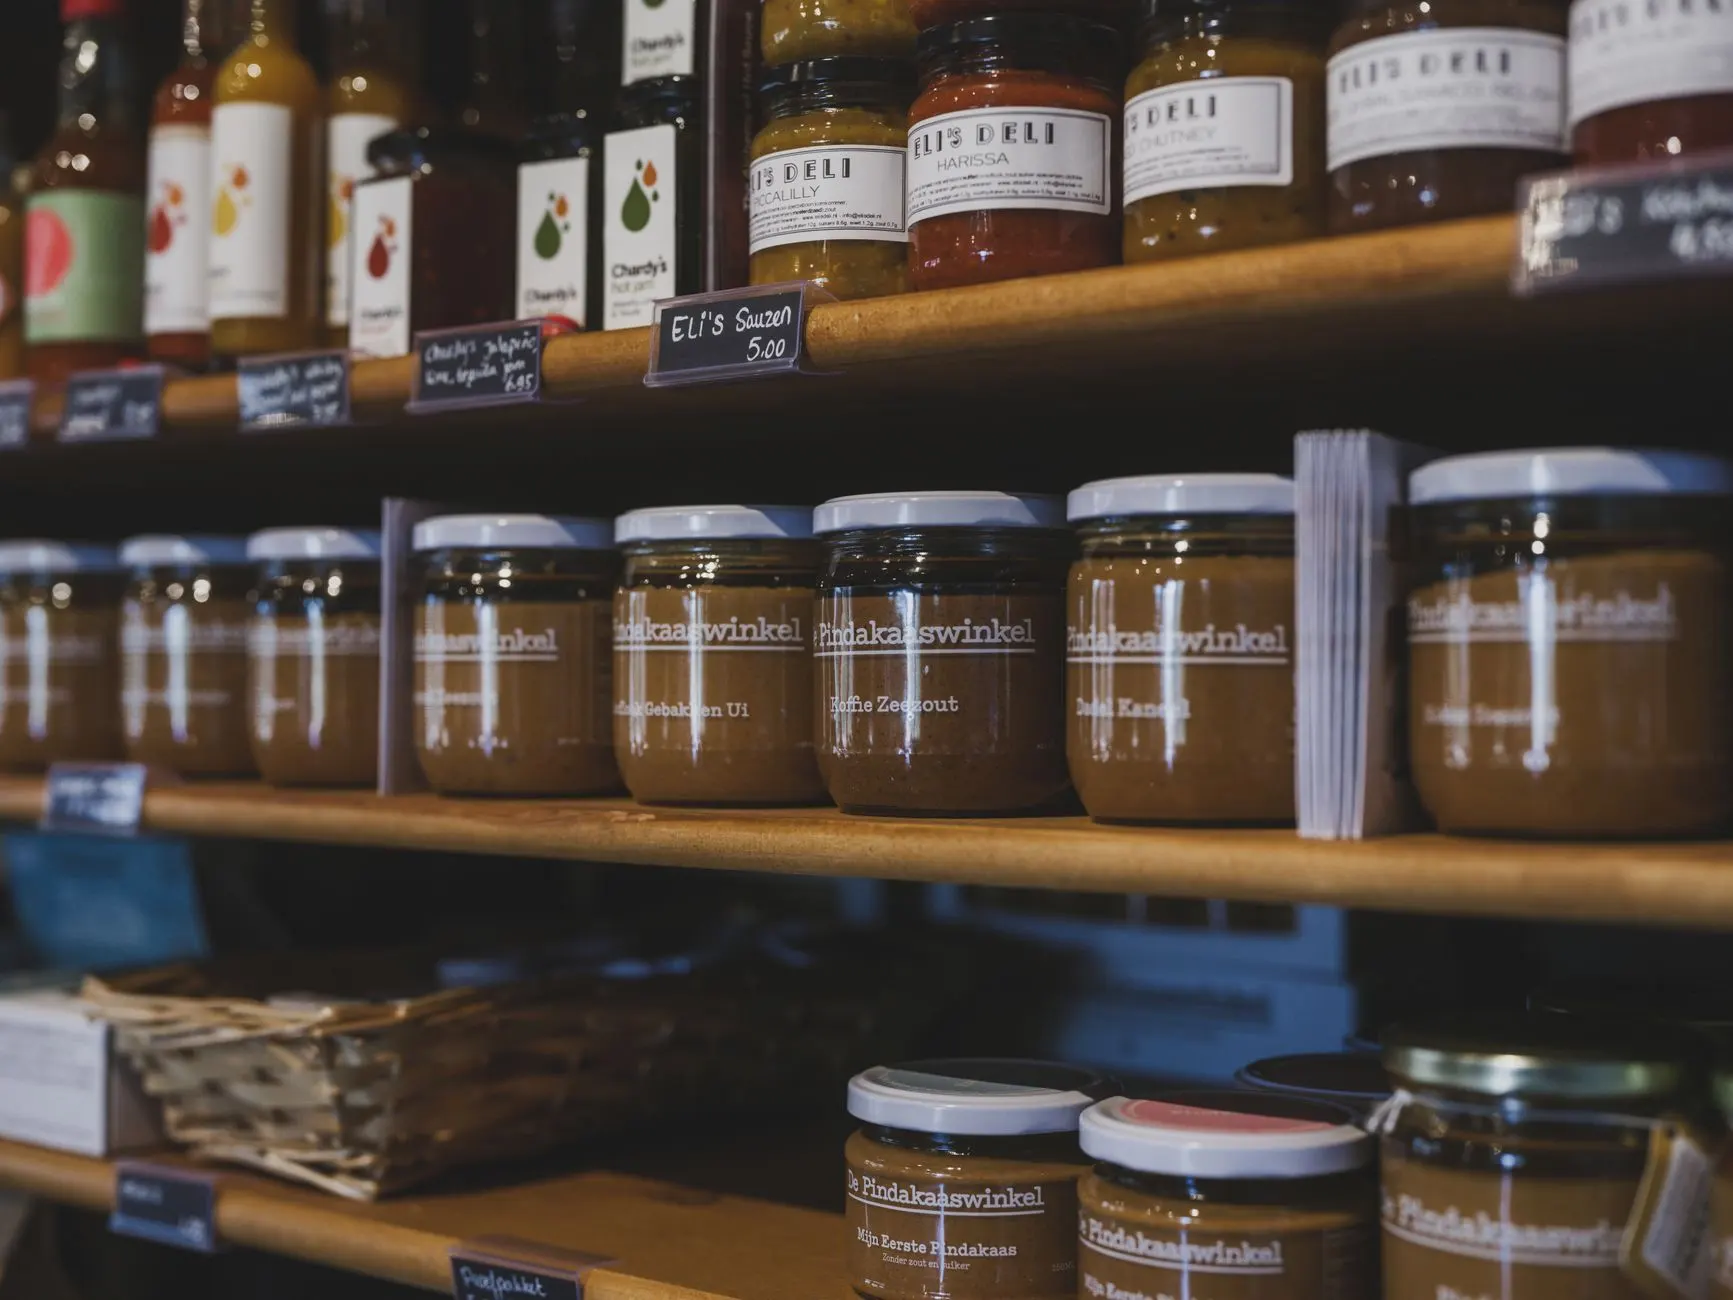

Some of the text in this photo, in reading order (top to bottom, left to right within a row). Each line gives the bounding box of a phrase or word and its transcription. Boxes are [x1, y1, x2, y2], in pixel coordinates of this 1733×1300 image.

[1146, 93, 1217, 129] DELI
[914, 121, 1055, 160] ELI'S DELI
[783, 157, 851, 184] DELI
[937, 151, 1010, 172] HARISSA
[735, 306, 792, 332] Sauzen
[819, 617, 1037, 649] Pindakaaswinkel
[726, 702, 749, 717] Ui
[830, 695, 872, 713] Koffie
[848, 1168, 1045, 1209] De Pindakaaswinkel
[857, 1226, 880, 1248] Mijn
[880, 1234, 927, 1254] Eerste
[882, 1252, 908, 1266] Zonder
[908, 1256, 928, 1268] zout
[928, 1260, 940, 1269] en
